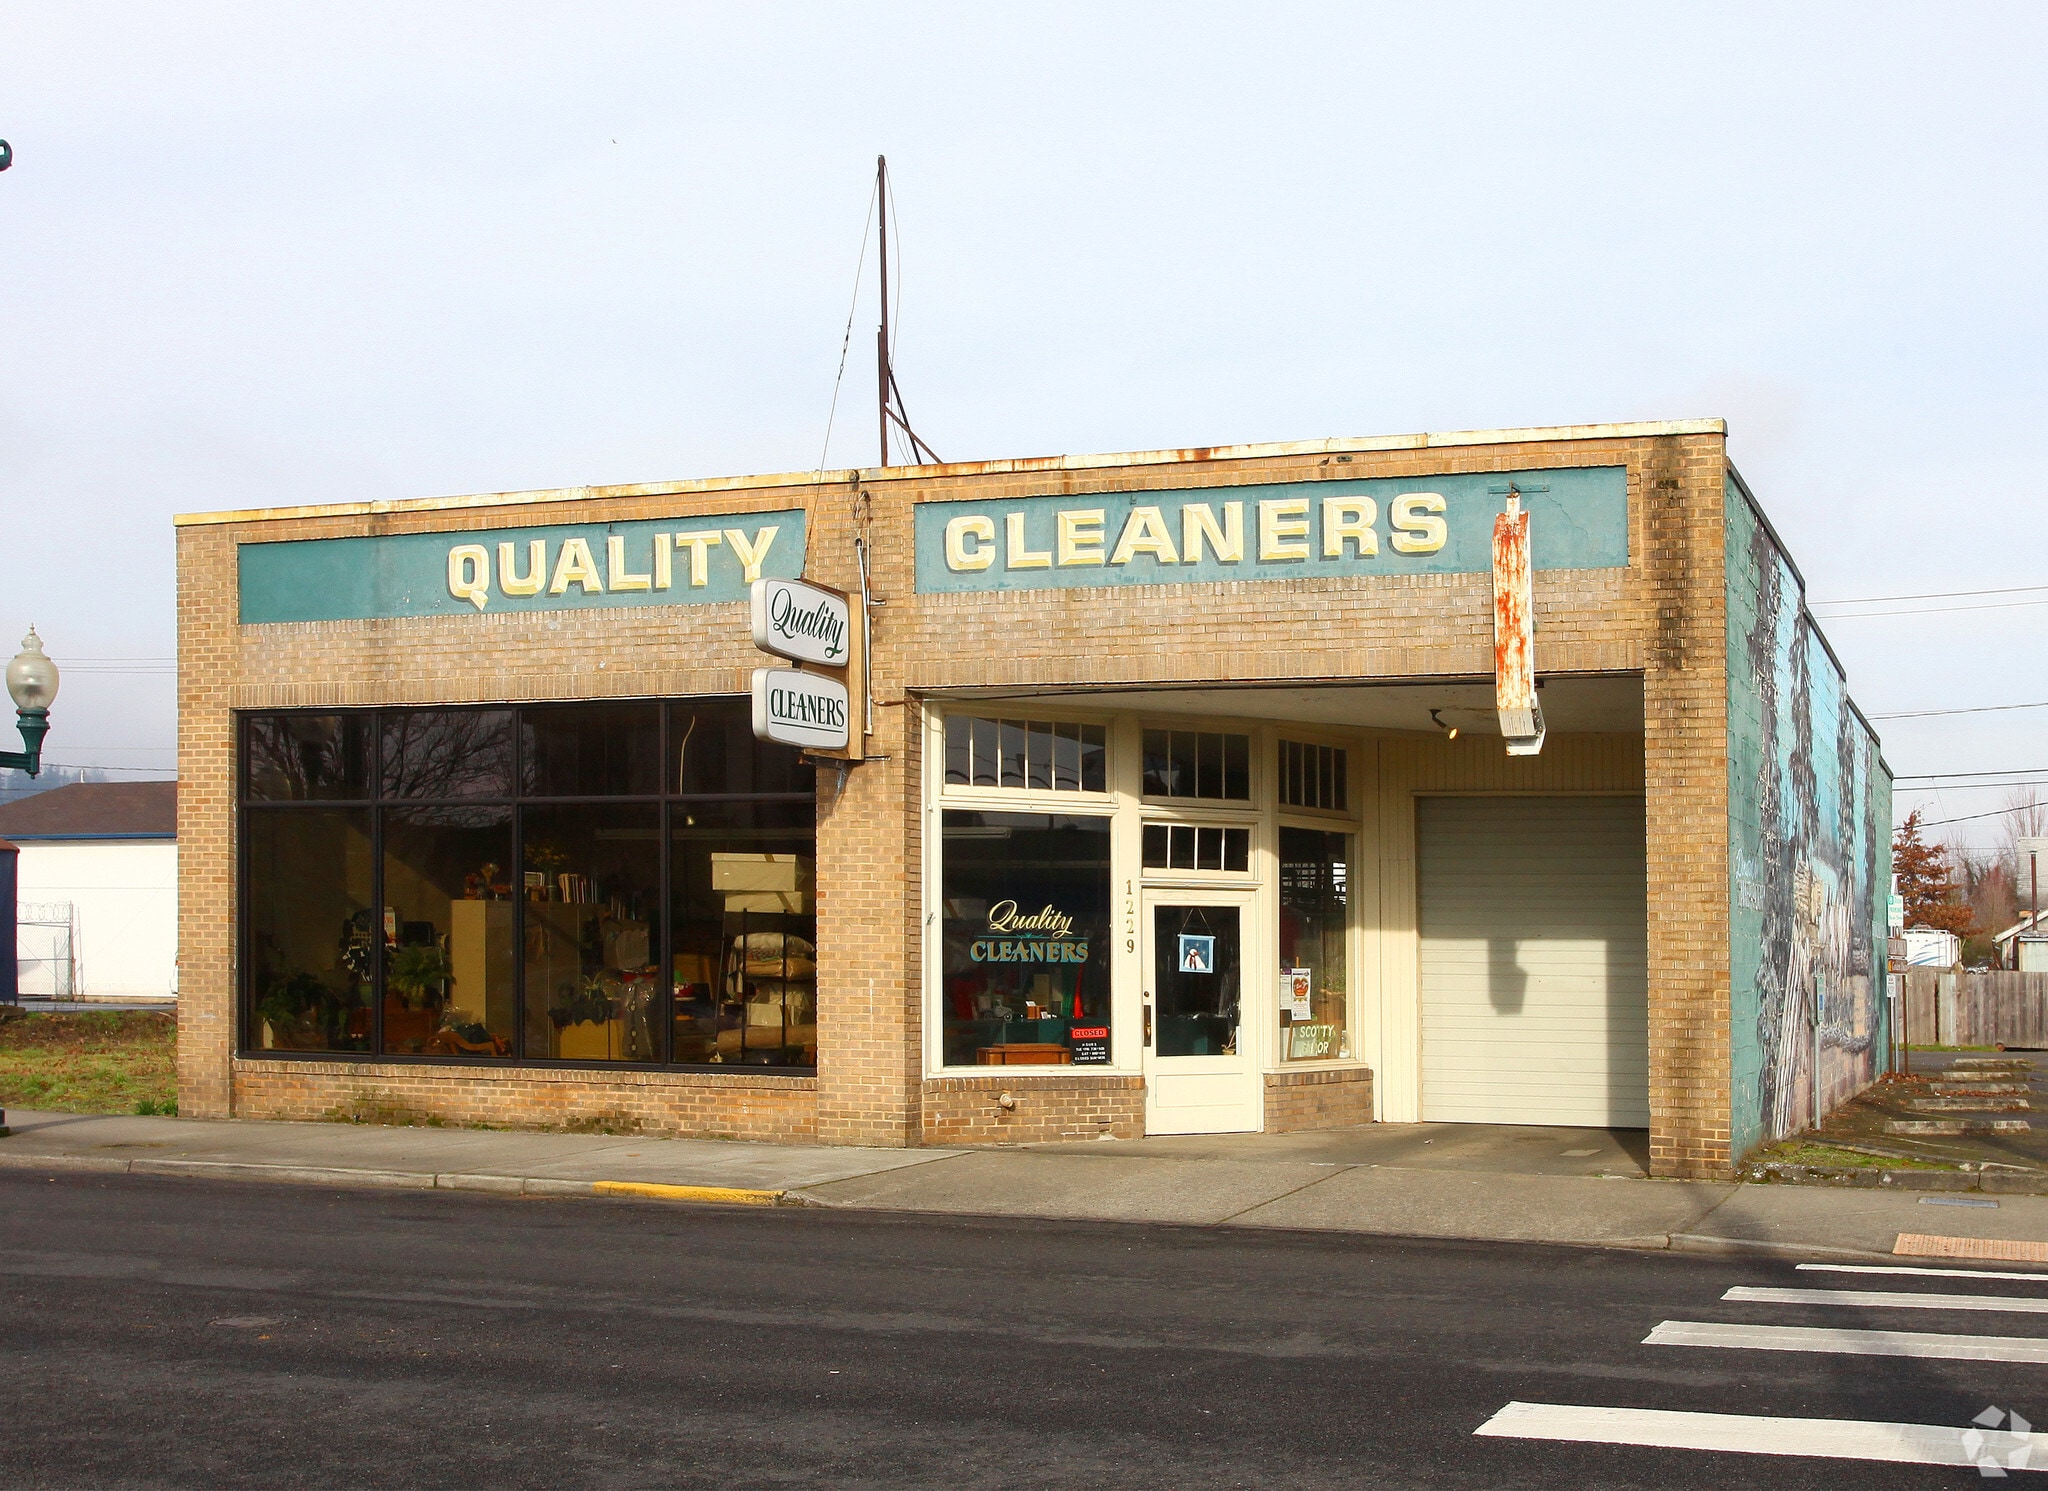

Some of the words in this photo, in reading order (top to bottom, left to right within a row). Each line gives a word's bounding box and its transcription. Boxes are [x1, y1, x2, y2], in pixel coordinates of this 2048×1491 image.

[448, 525, 780, 611] QUALITY
[944, 493, 1448, 572] CLEANERS
[771, 588, 844, 659] Quality
[770, 688, 845, 729] CLEANERS
[970, 940, 1089, 963] CLEANERS
[988, 899, 1073, 939] Quality
[1126, 879, 1135, 954] 1229
